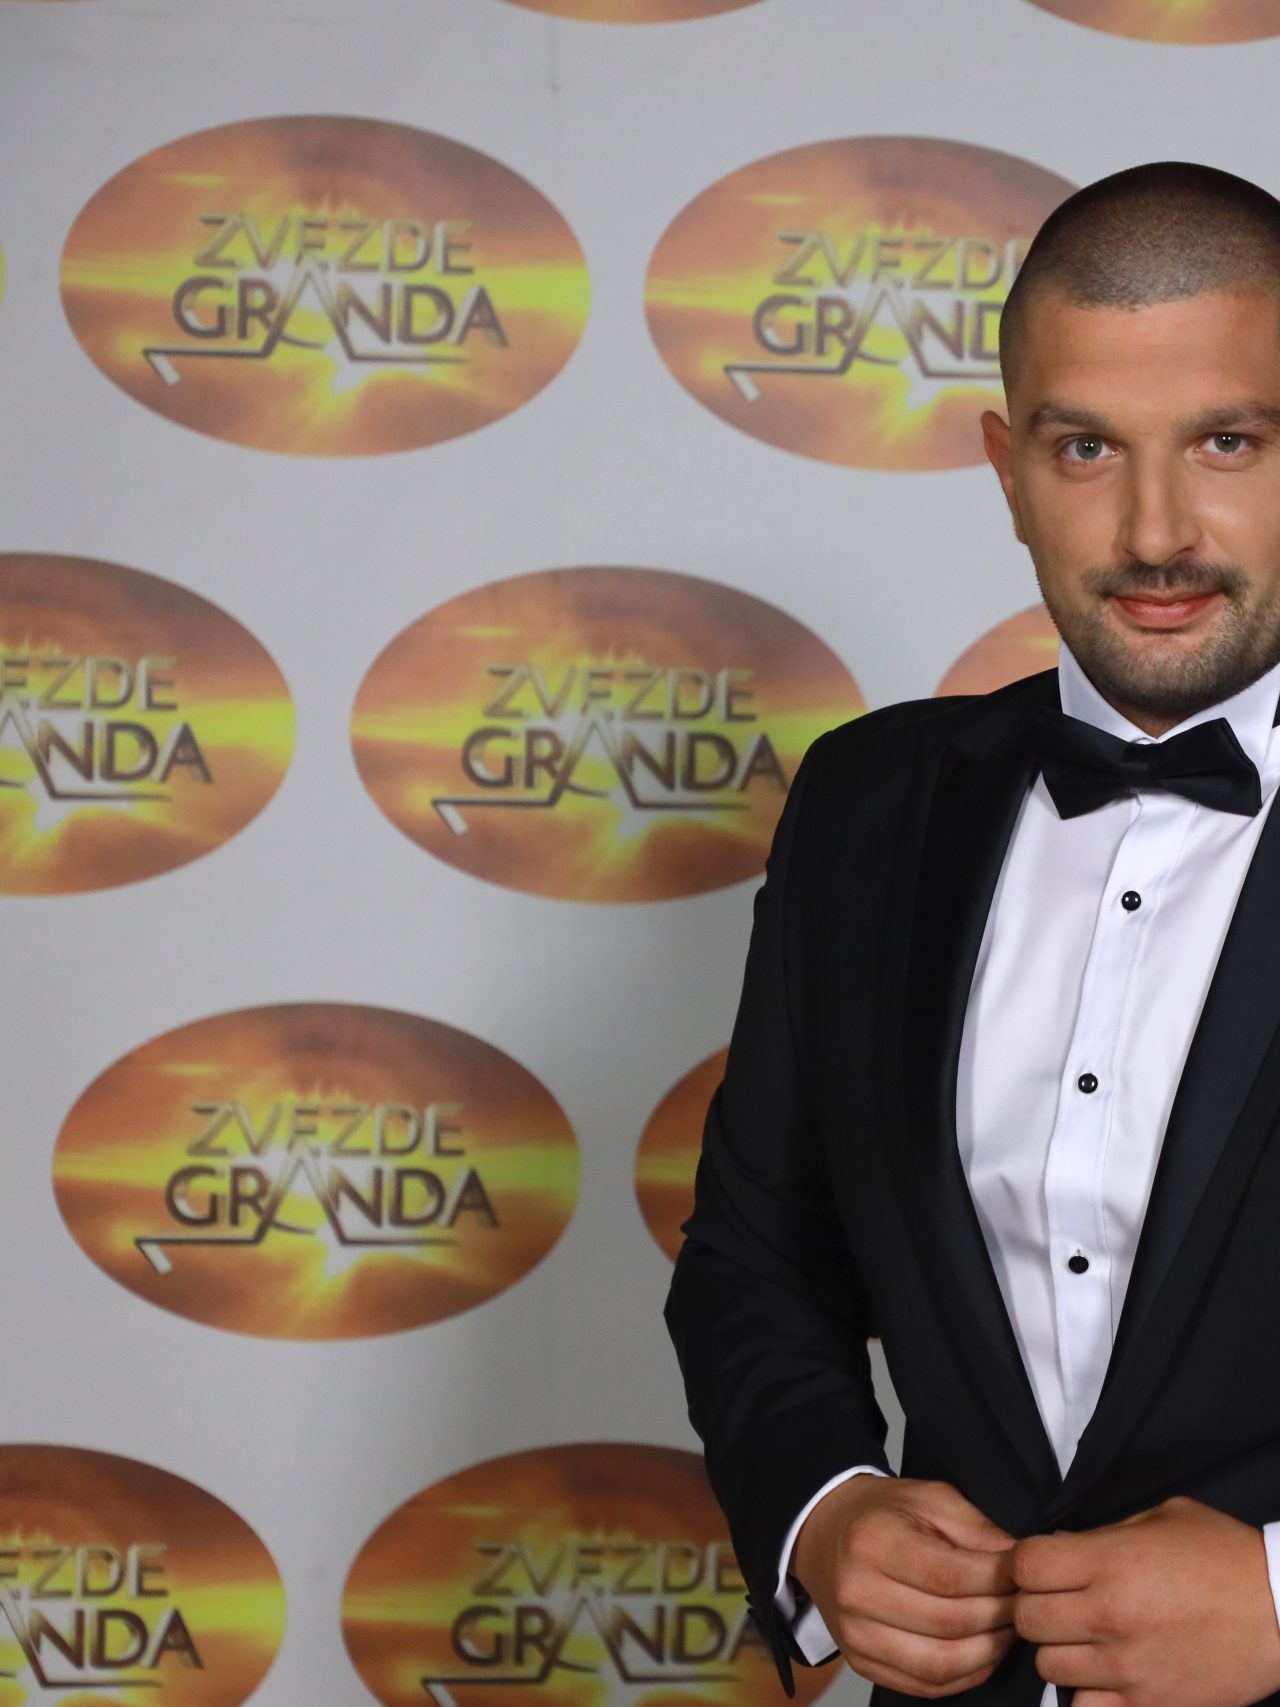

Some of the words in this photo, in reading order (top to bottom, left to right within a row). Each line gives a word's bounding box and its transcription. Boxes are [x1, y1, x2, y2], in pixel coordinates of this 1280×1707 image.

[172, 256, 509, 361] GRANDA
[0, 656, 180, 712] EZDE
[460, 709, 788, 810] GRANDA
[165, 1143, 501, 1247] GRANDA
